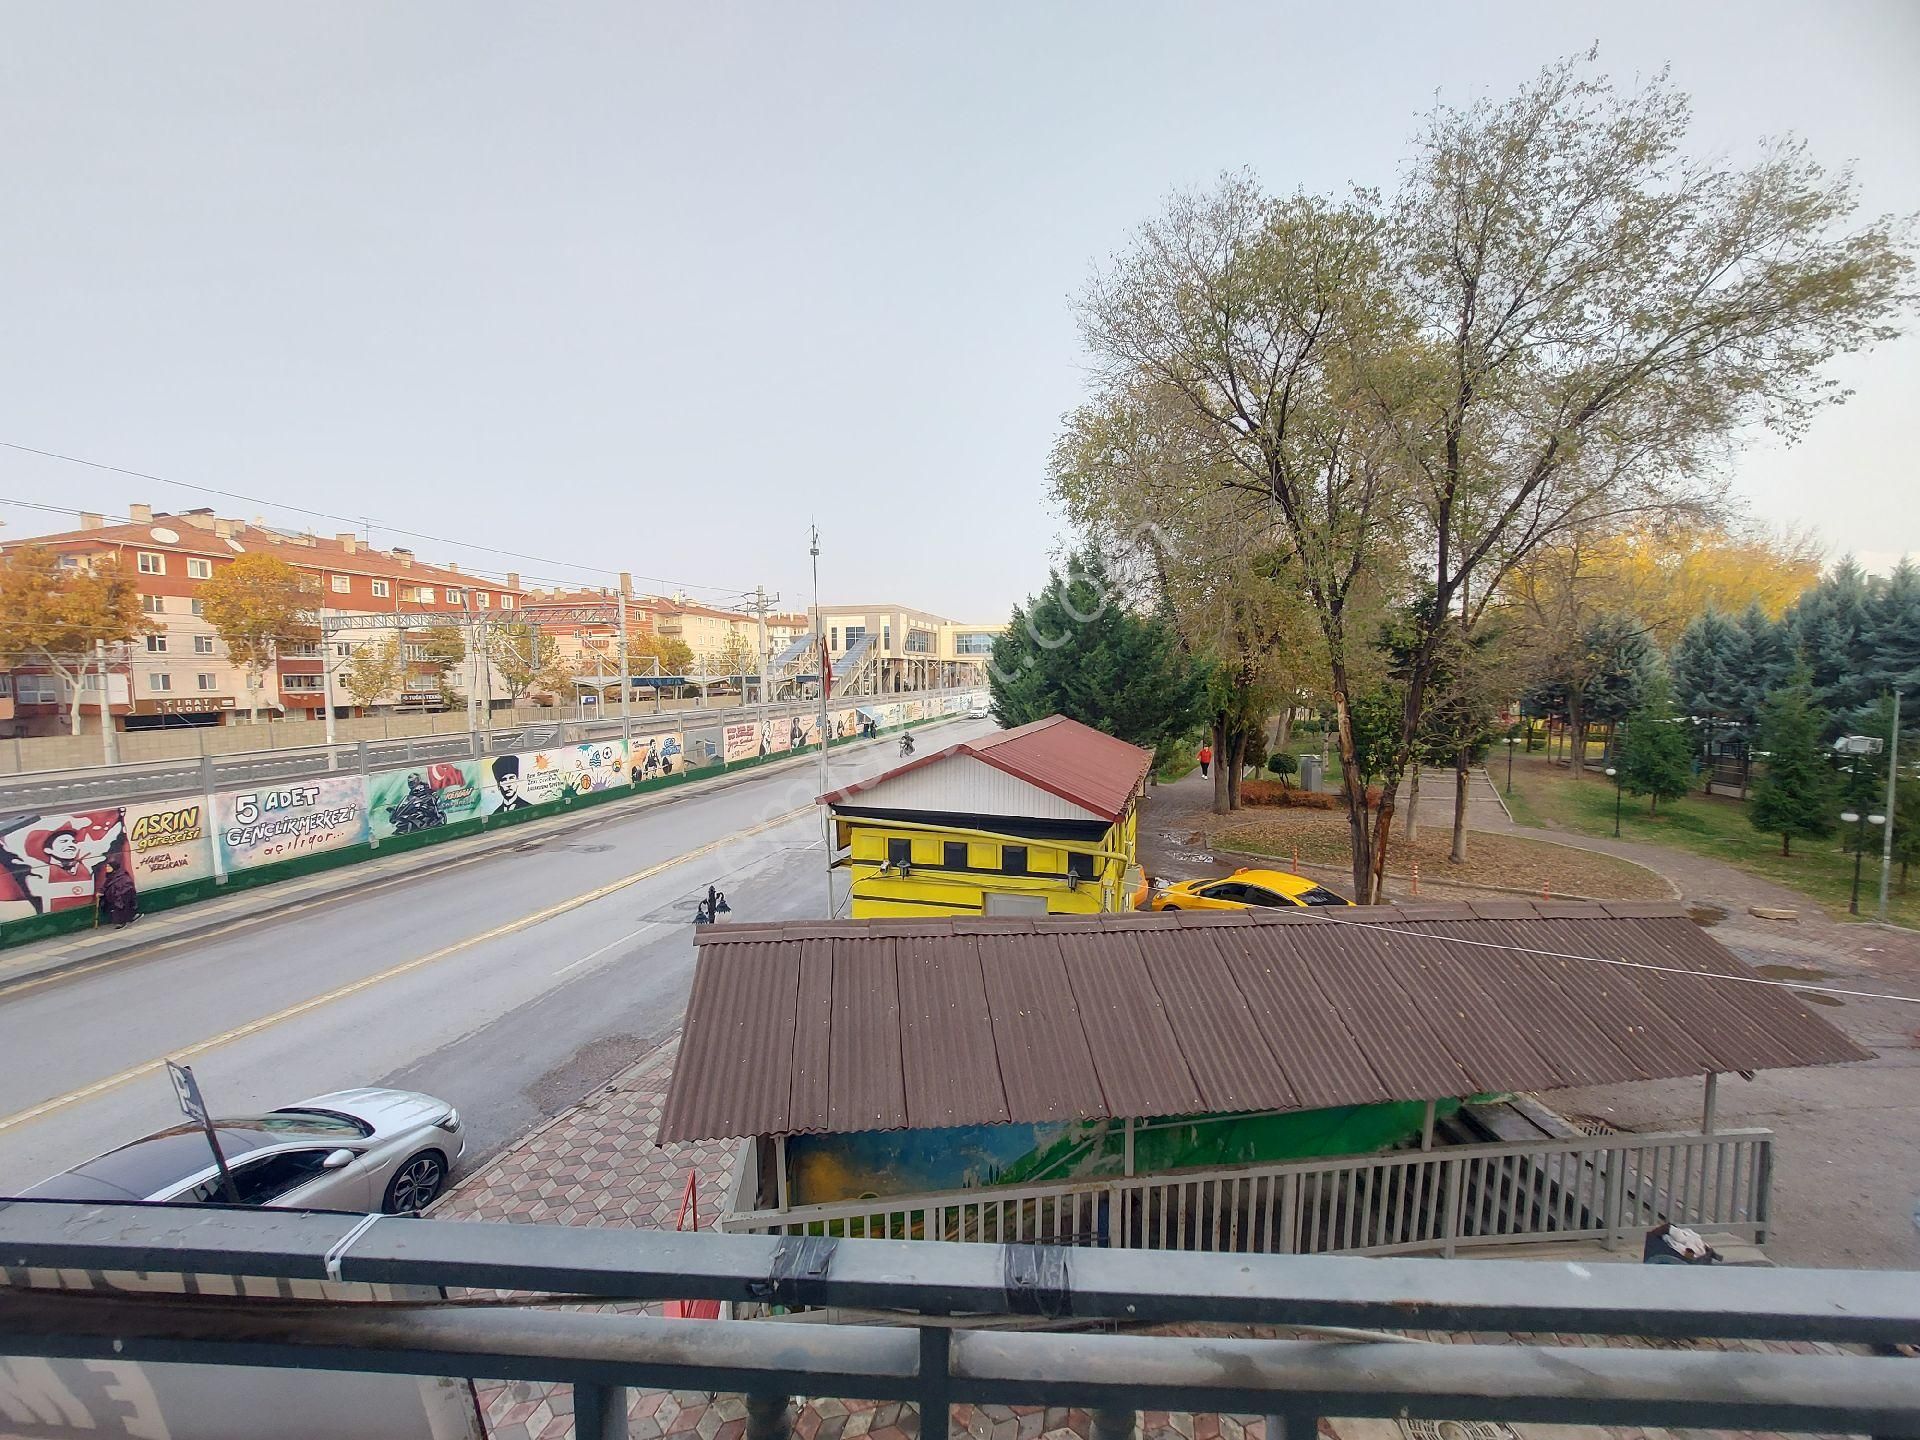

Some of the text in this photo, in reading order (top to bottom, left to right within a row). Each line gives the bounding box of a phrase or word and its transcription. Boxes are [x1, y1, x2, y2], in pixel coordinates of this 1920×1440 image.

[131, 806, 200, 842] ASRIN
[235, 787, 321, 825] 5 ADET
